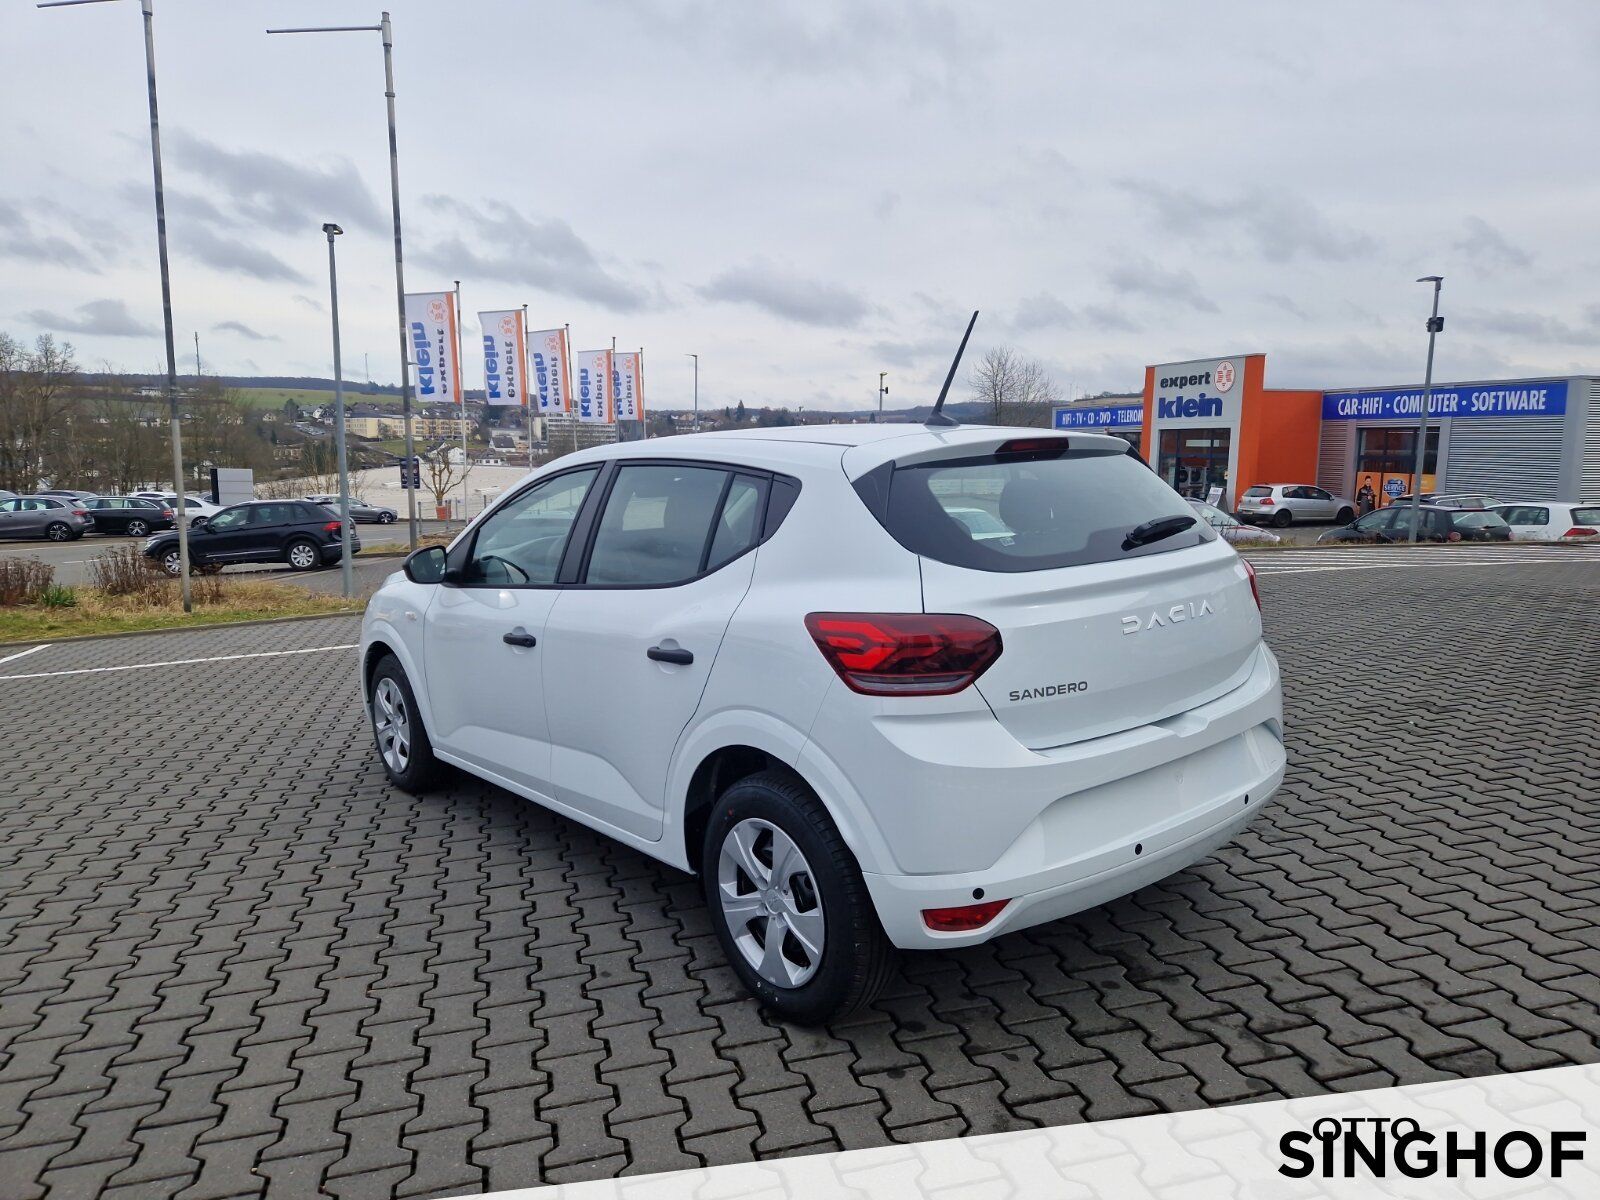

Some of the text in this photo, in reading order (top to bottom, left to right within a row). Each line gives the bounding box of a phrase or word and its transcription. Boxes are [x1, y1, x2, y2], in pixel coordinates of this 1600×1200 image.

[1160, 371, 1211, 389] expert
[1158, 392, 1223, 419] klein
[1337, 396, 1383, 416] CAR-HIFI
[1471, 389, 1547, 412] SOFTWARE
[1076, 412, 1084, 424] TV
[1087, 412, 1095, 424] CD
[1099, 411, 1111, 424] DVD
[1121, 600, 1214, 635] DACIA
[1009, 681, 1088, 701] SANDERO
